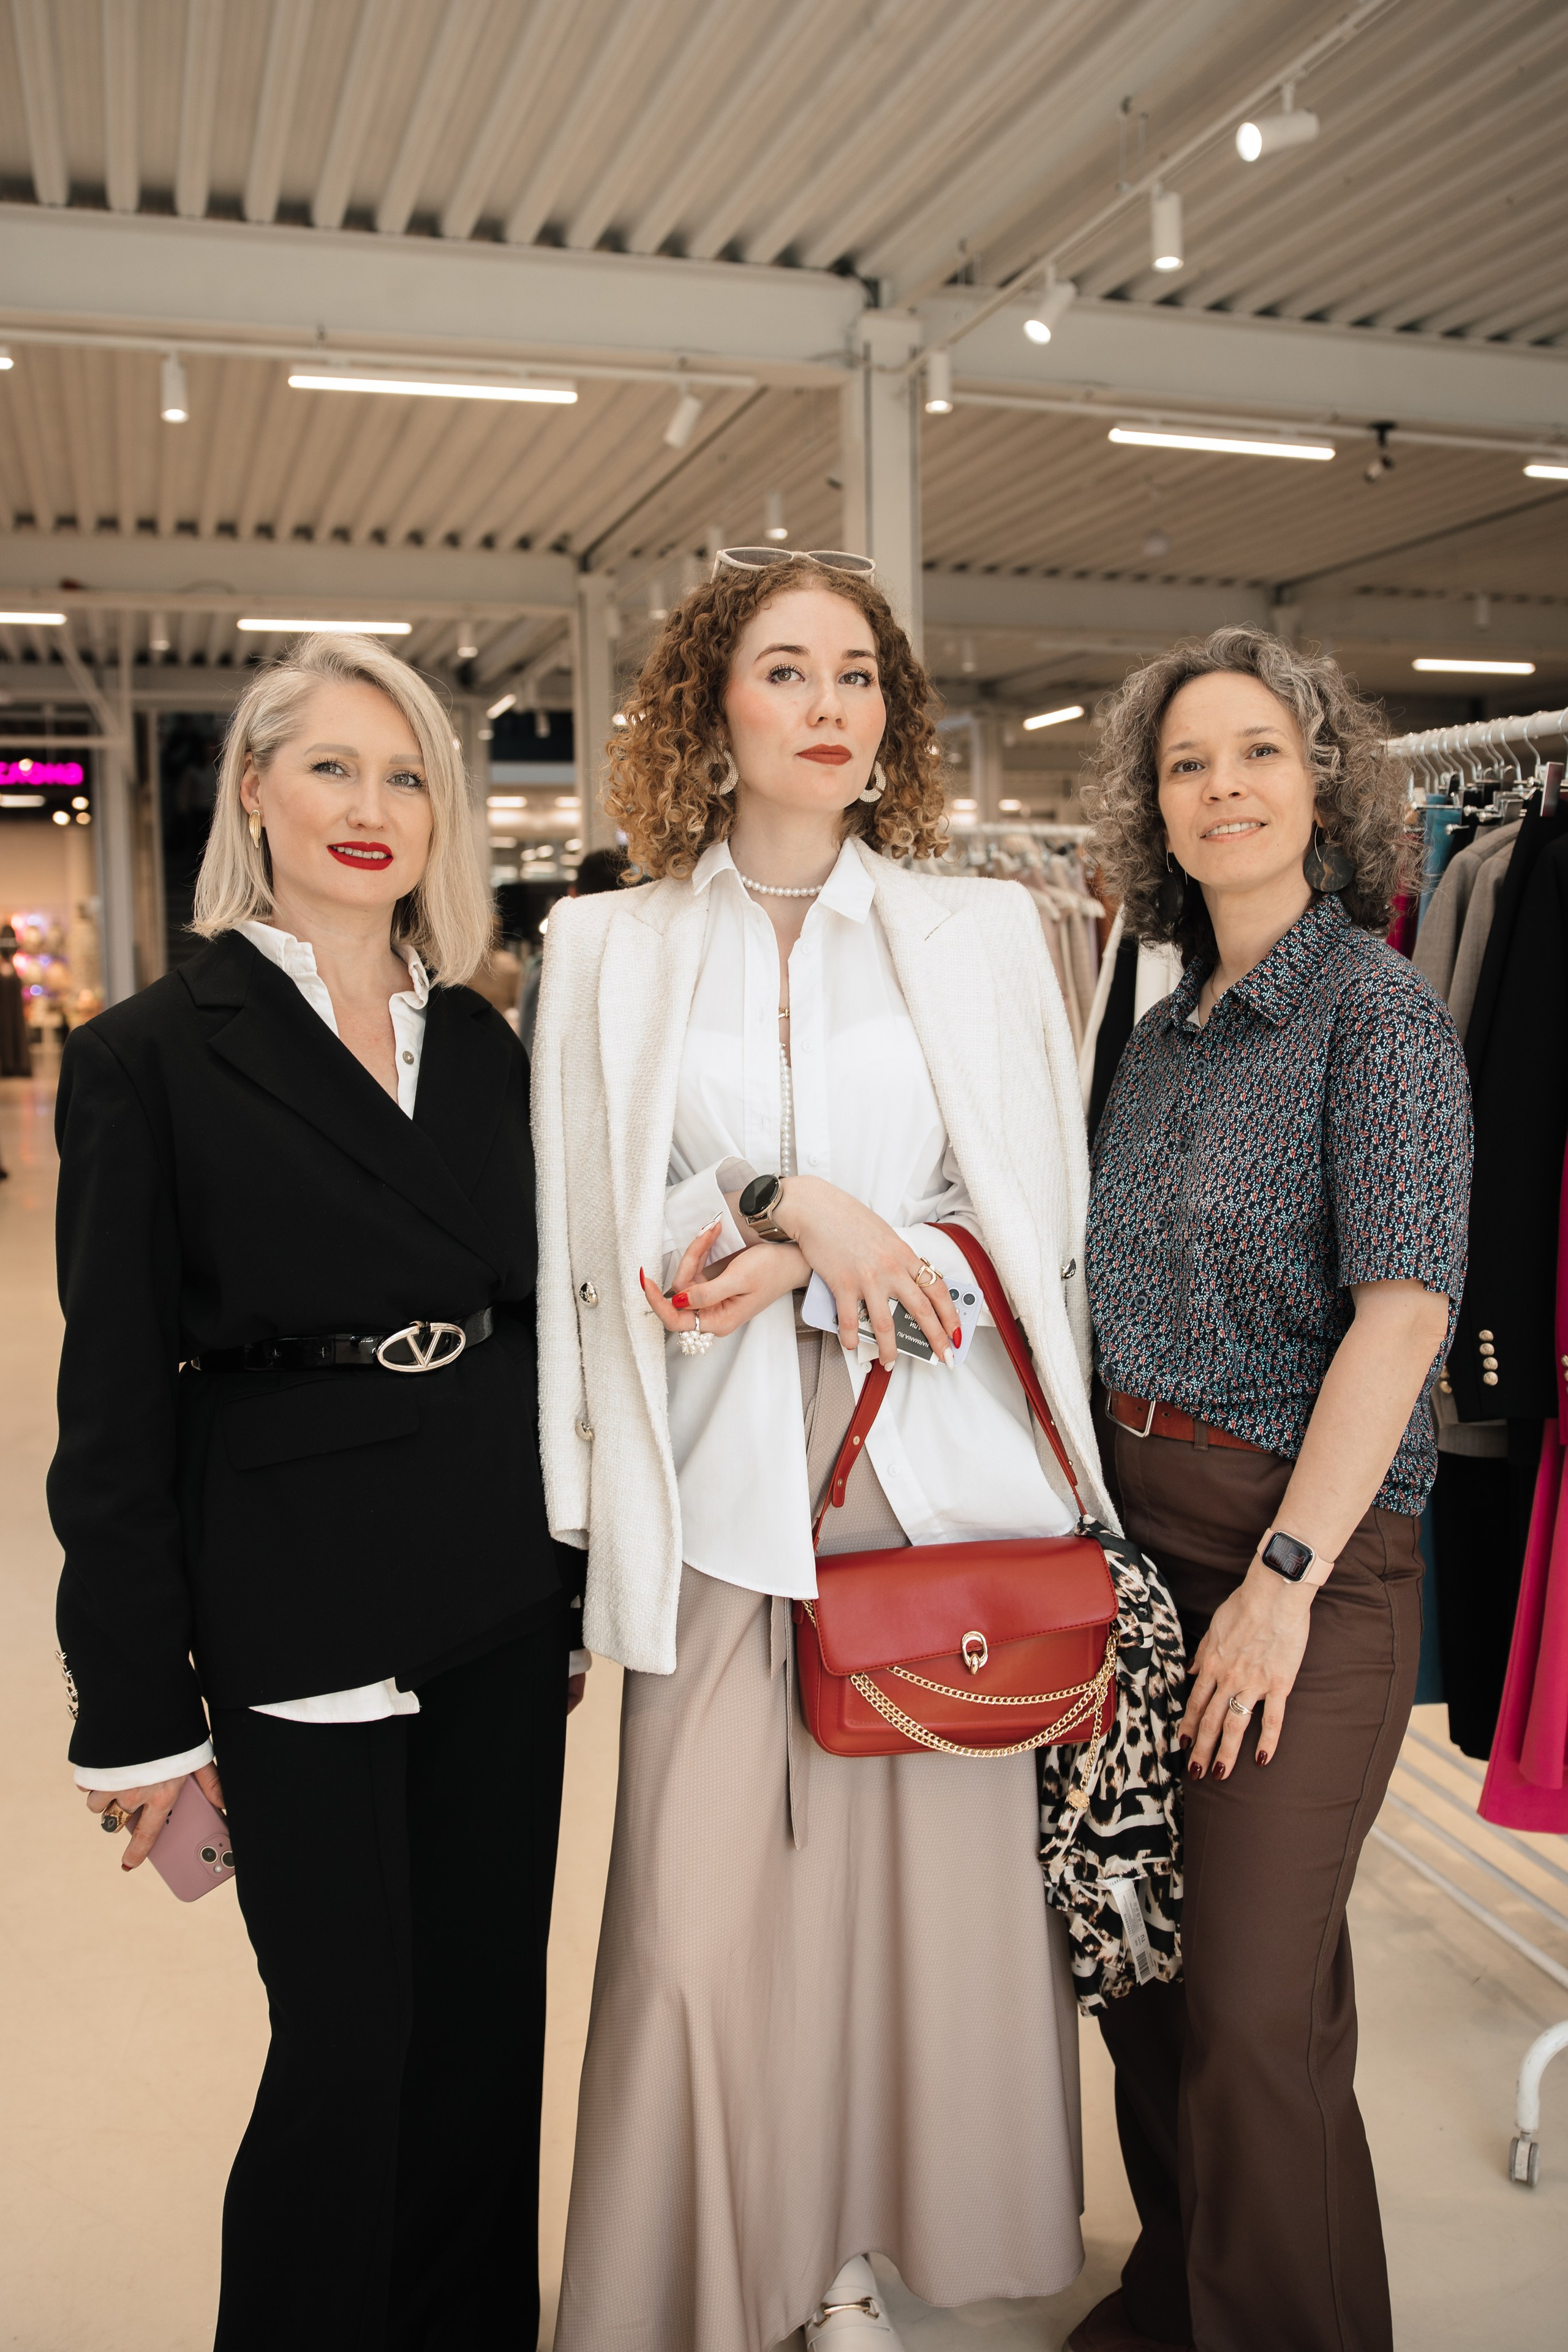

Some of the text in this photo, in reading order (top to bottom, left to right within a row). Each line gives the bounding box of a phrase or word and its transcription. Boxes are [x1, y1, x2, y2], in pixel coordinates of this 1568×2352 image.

[897, 1331, 929, 1348] NARMANIA.RU
[1282, 1553, 1306, 1577] 12
[1140, 1934, 1146, 1943] TU
